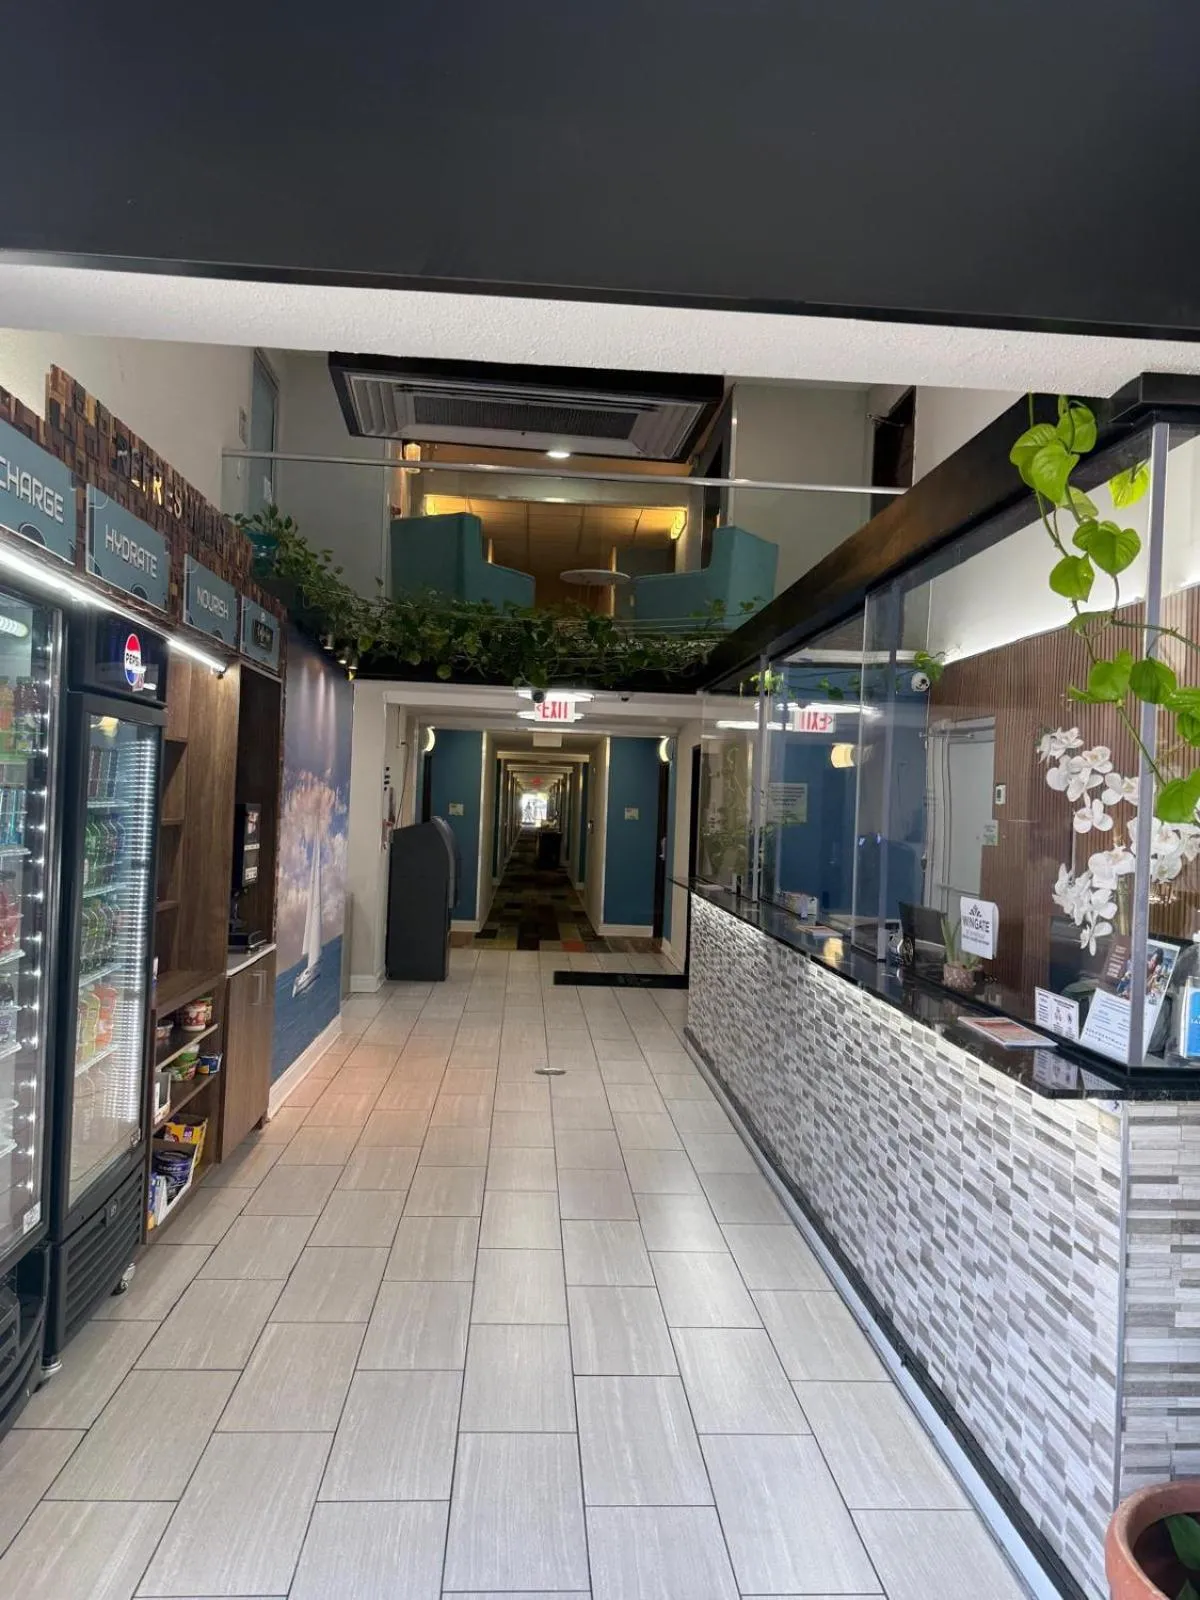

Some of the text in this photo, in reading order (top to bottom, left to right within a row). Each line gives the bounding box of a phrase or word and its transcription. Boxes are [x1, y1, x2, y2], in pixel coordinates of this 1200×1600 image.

[105, 523, 158, 579] HYDRATE
[126, 652, 140, 667] PEPS
[542, 701, 568, 719] EXIT
[962, 915, 990, 933] WINGATE
